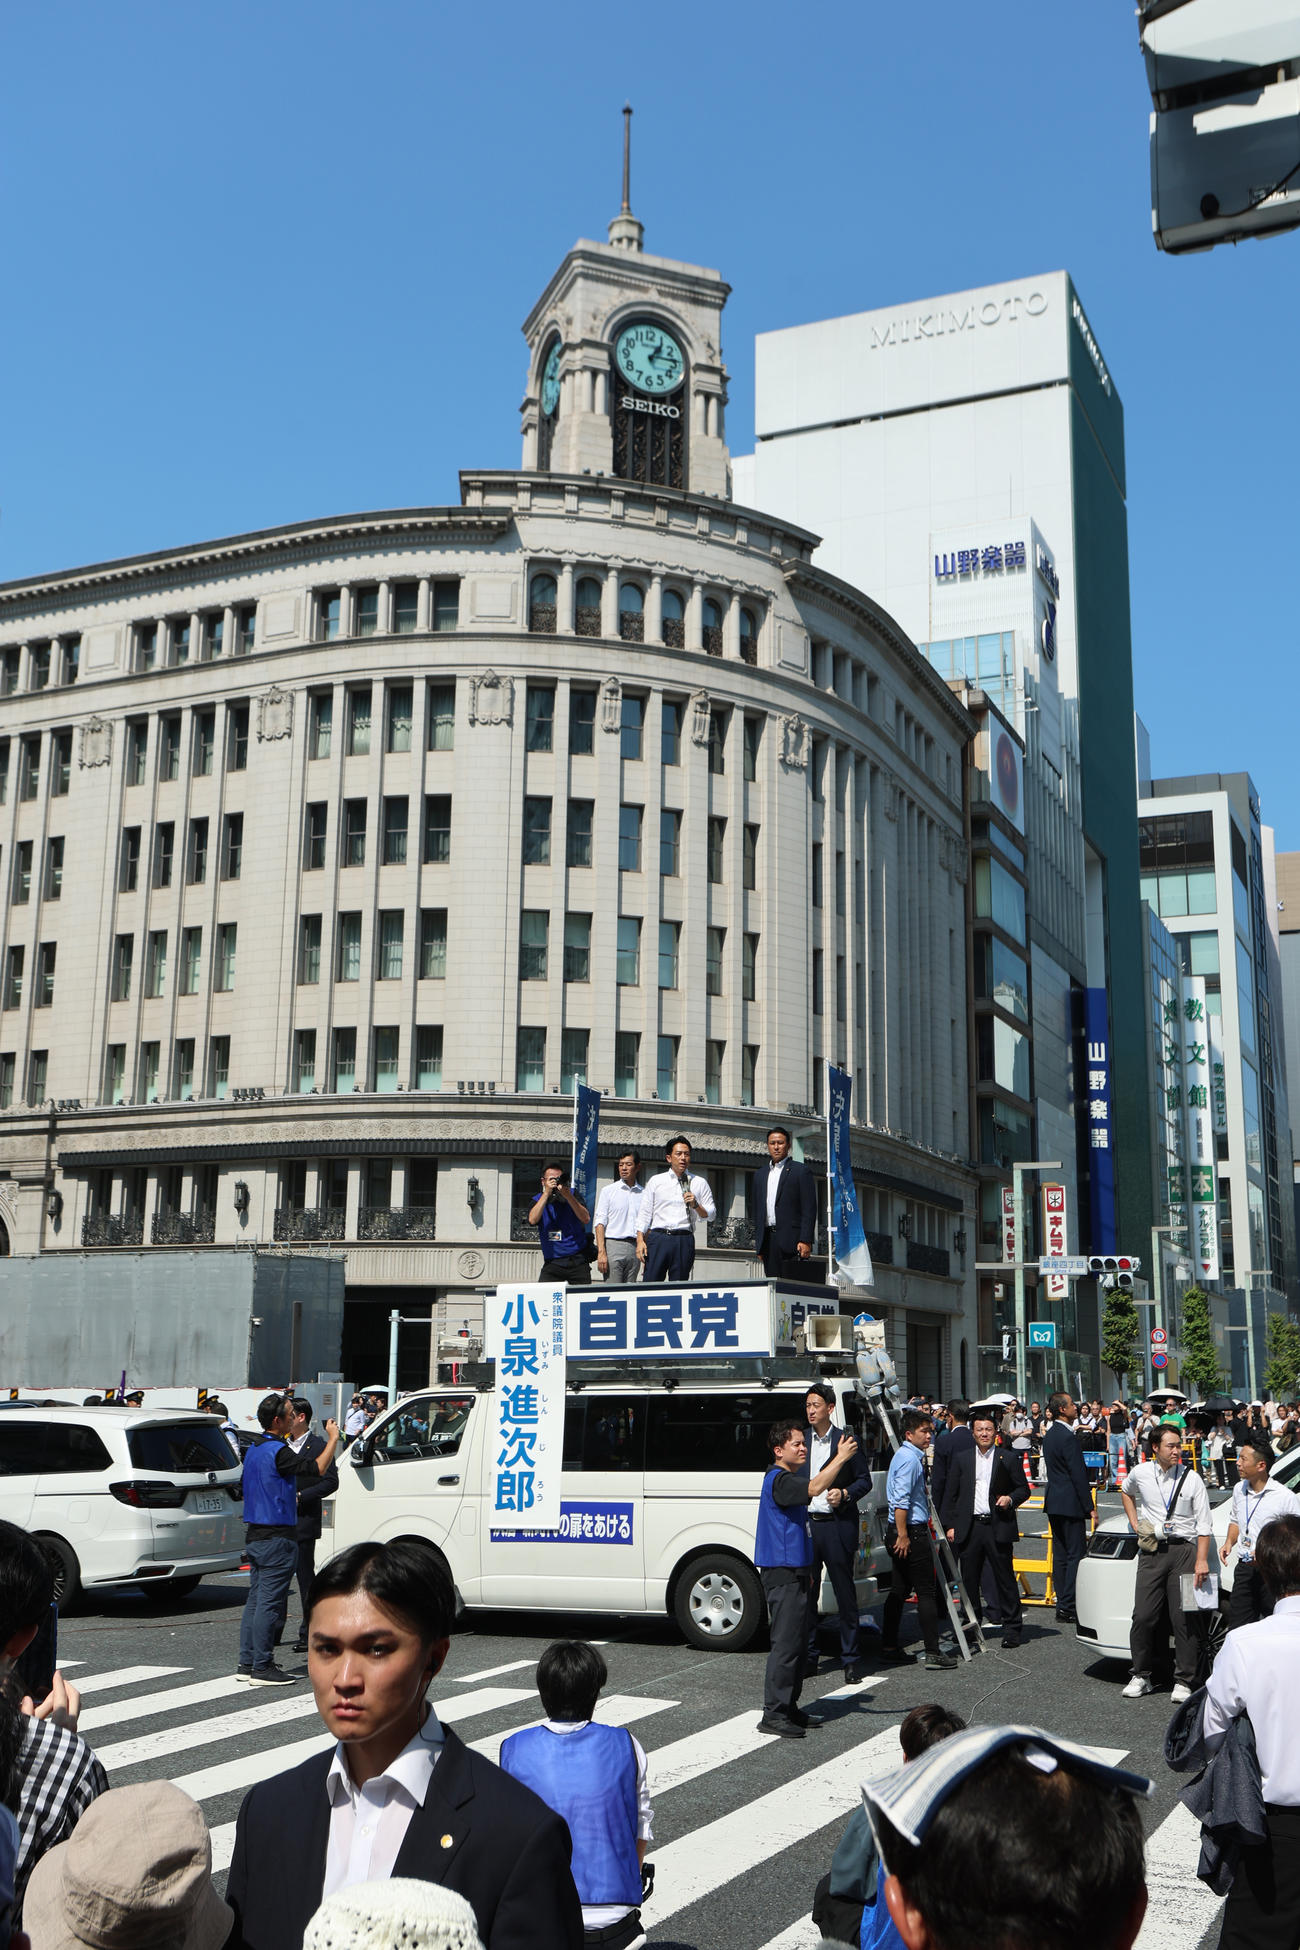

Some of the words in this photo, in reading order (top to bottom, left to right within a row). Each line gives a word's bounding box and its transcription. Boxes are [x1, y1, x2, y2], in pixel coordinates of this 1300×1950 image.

[646, 330, 656, 341] 12
[871, 292, 1048, 349] MIKIMOTO
[622, 396, 680, 418] SEIKO
[935, 541, 1025, 577] 山野楽器
[1184, 998, 1207, 1110] 教文館
[1088, 1042, 1108, 1148] 山野楽器
[1193, 1172, 1212, 1196] 本
[552, 1292, 563, 1356] 衆議院議員
[580, 1293, 739, 1350] 自民党
[495, 1294, 541, 1512] 小泉進次郎
